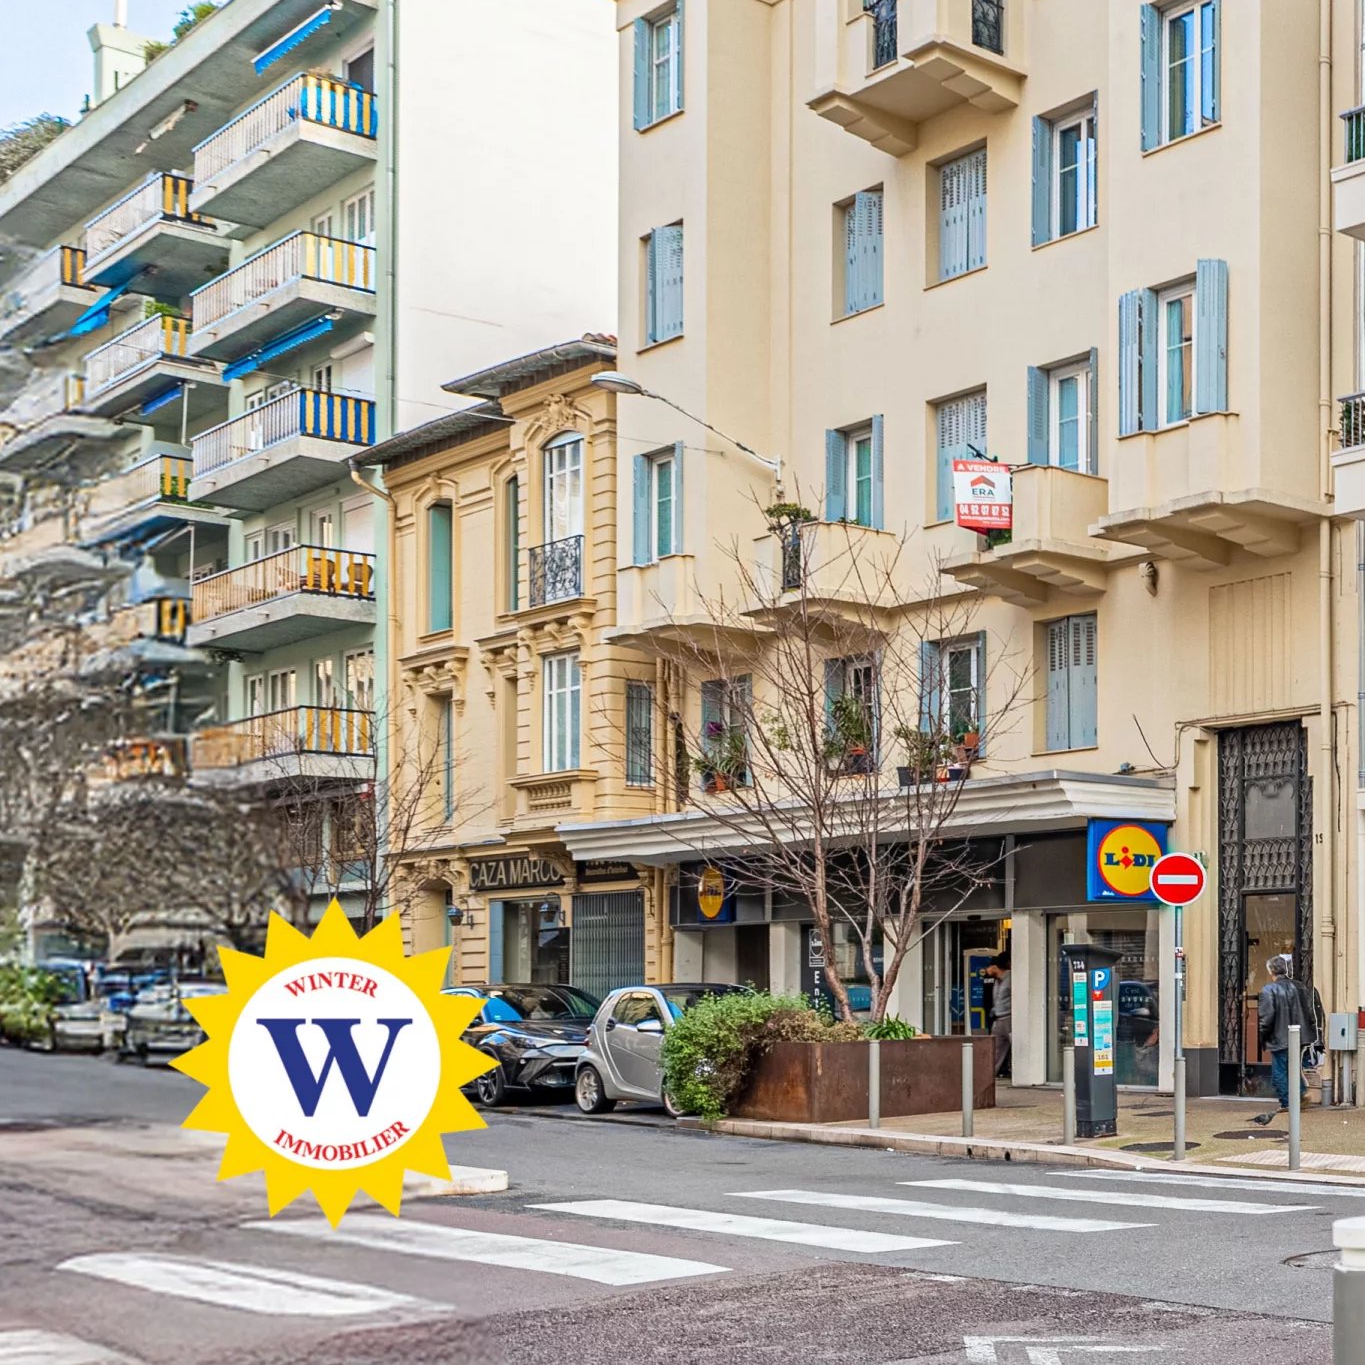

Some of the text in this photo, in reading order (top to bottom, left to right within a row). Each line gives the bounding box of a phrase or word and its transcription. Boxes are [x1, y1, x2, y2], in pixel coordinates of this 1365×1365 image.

[968, 464, 1006, 473] VENDRE
[972, 488, 995, 497] ERA
[470, 861, 507, 887] CAZA
[1094, 970, 1106, 988] P
